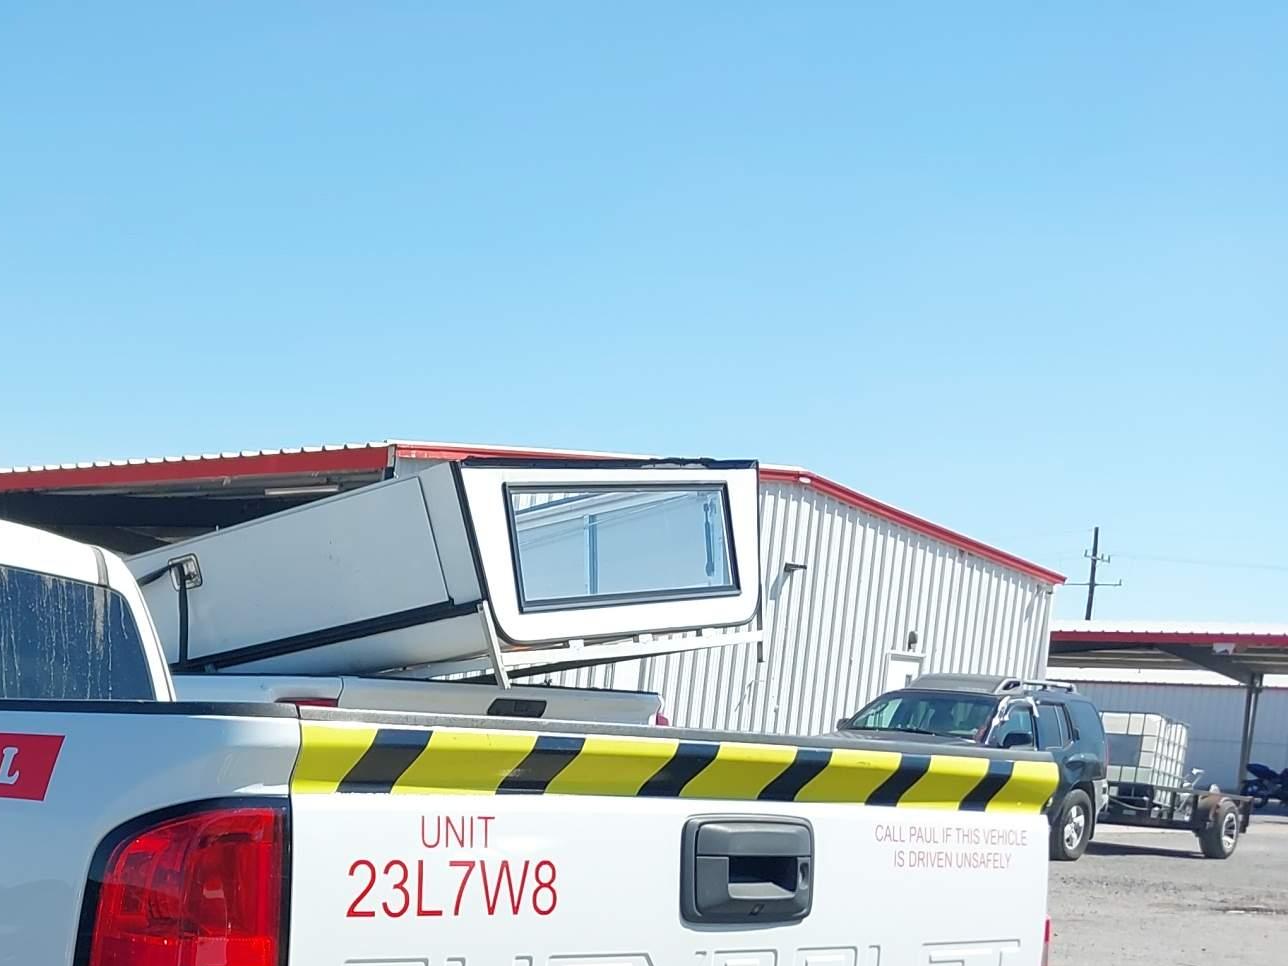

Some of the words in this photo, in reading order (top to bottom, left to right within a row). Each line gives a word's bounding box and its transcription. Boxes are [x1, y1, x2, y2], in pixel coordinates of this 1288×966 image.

[420, 814, 496, 849] UNIT
[874, 824, 906, 843] CALL
[909, 826, 939, 844] PAUL
[942, 827, 953, 844] IF
[956, 828, 981, 845] THIS
[982, 829, 1027, 846] VEHICLE
[894, 850, 905, 867] IS
[908, 851, 953, 868] DRIVEN
[956, 852, 1012, 869] UNSAFELY
[346, 858, 558, 918] 23L7W8
